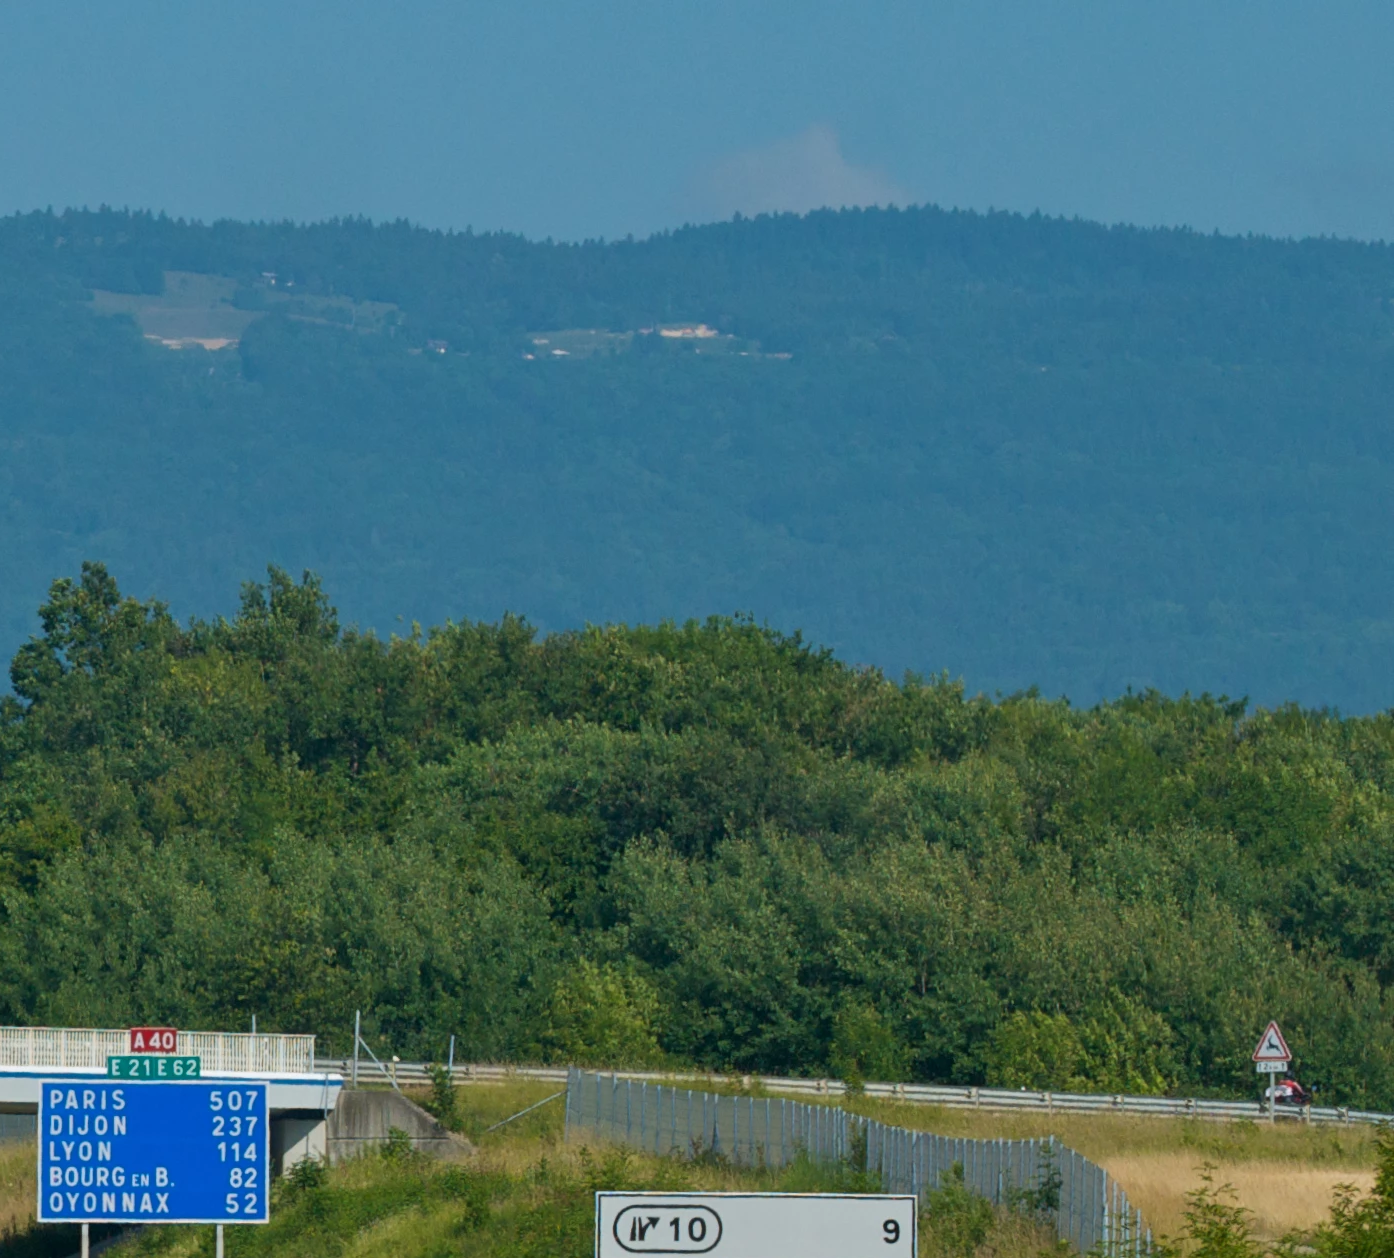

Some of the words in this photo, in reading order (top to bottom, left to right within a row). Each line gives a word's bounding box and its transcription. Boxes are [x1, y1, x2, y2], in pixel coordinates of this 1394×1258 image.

[50, 1089, 126, 1111] PARIS
[210, 1090, 259, 1111] 507
[50, 1114, 127, 1136] DIJON
[212, 1115, 258, 1137] 237
[50, 1140, 112, 1162] LYON
[218, 1141, 257, 1162] 114
[50, 1166, 126, 1187] BOURG
[132, 1173, 150, 1187] EN
[156, 1166, 175, 1188] B.
[230, 1167, 258, 1189] 82
[50, 1191, 170, 1213] OYONNAX
[225, 1192, 258, 1214] 52
[669, 1216, 707, 1243] 10
[883, 1218, 901, 1245] 9
